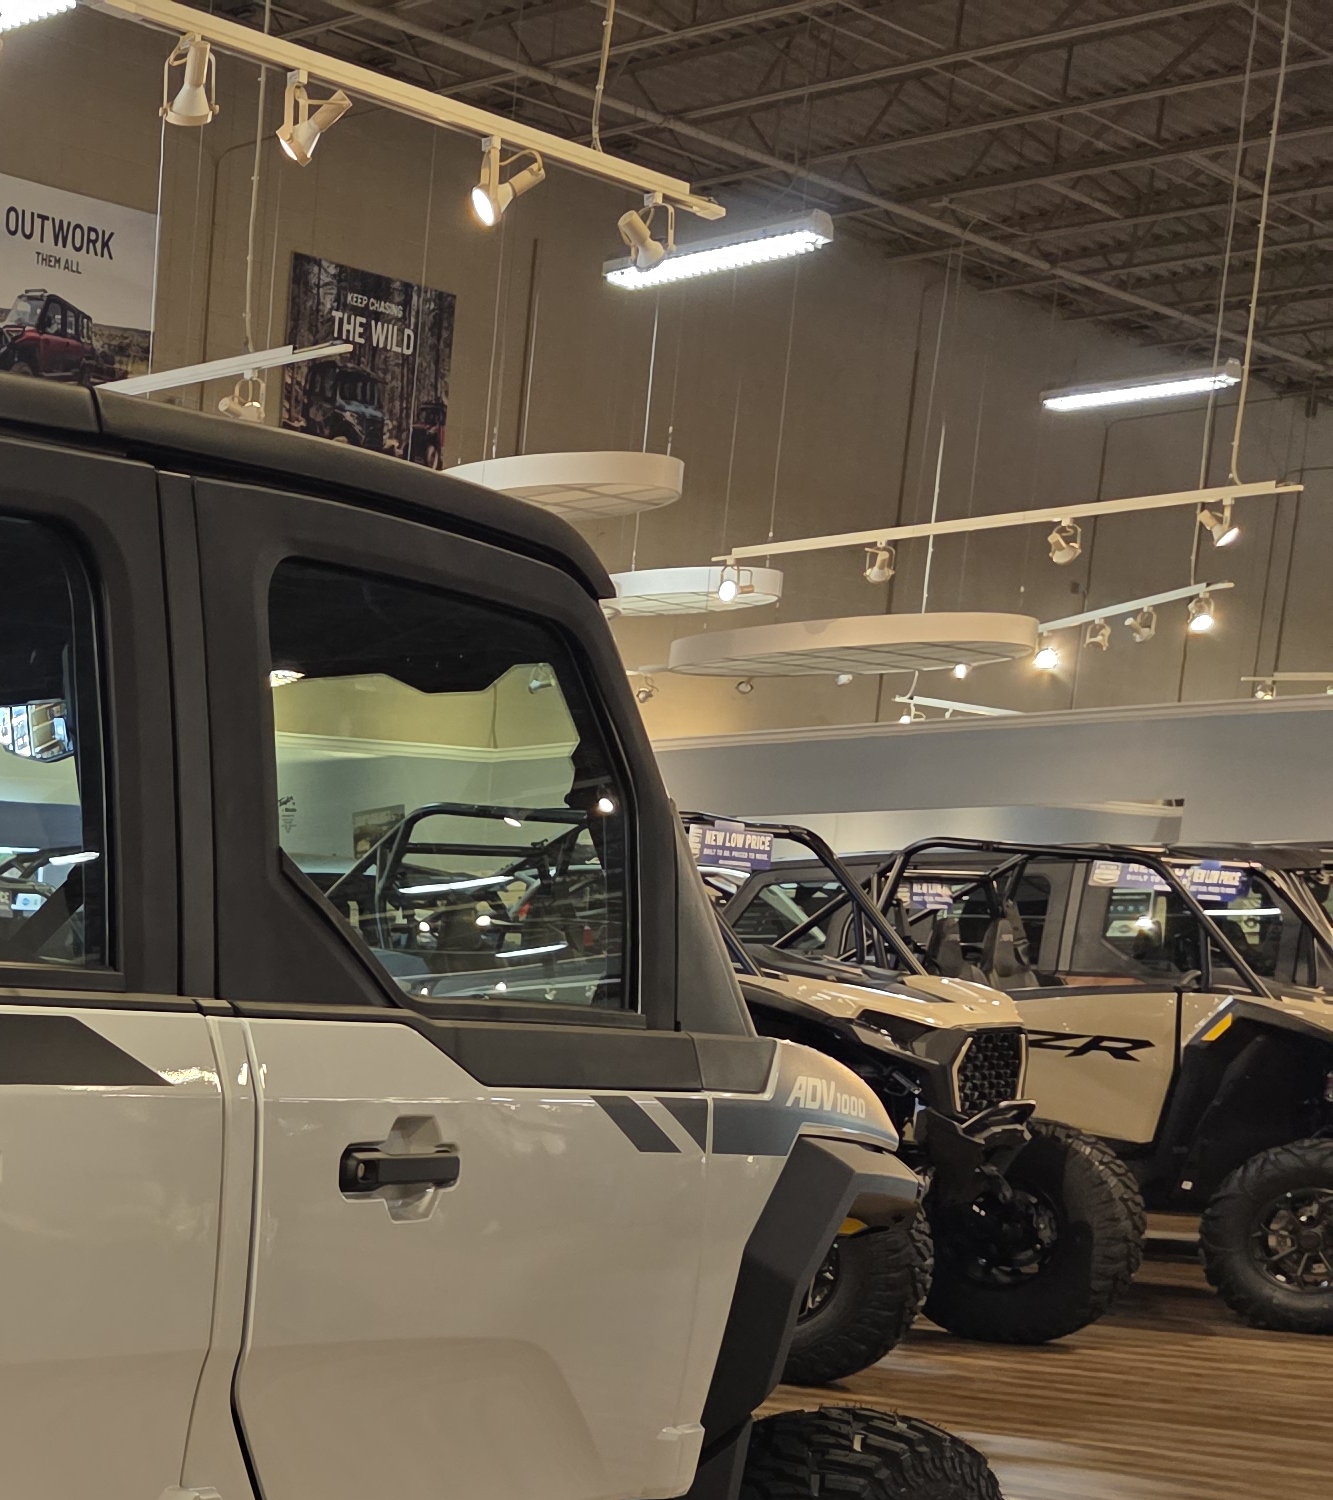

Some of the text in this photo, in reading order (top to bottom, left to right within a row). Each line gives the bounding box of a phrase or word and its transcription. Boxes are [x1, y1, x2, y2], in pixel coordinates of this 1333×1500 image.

[5, 206, 115, 260] OUTWORK
[35, 251, 82, 274] THEM ALL
[347, 292, 403, 318] KEEP CHASING
[331, 310, 414, 355] THE WILD
[705, 829, 725, 846] NEW
[725, 832, 745, 848] LOW
[745, 834, 772, 851] PRICE
[1028, 1029, 1155, 1062] ZR
[786, 1075, 866, 1119] ADV 1000
